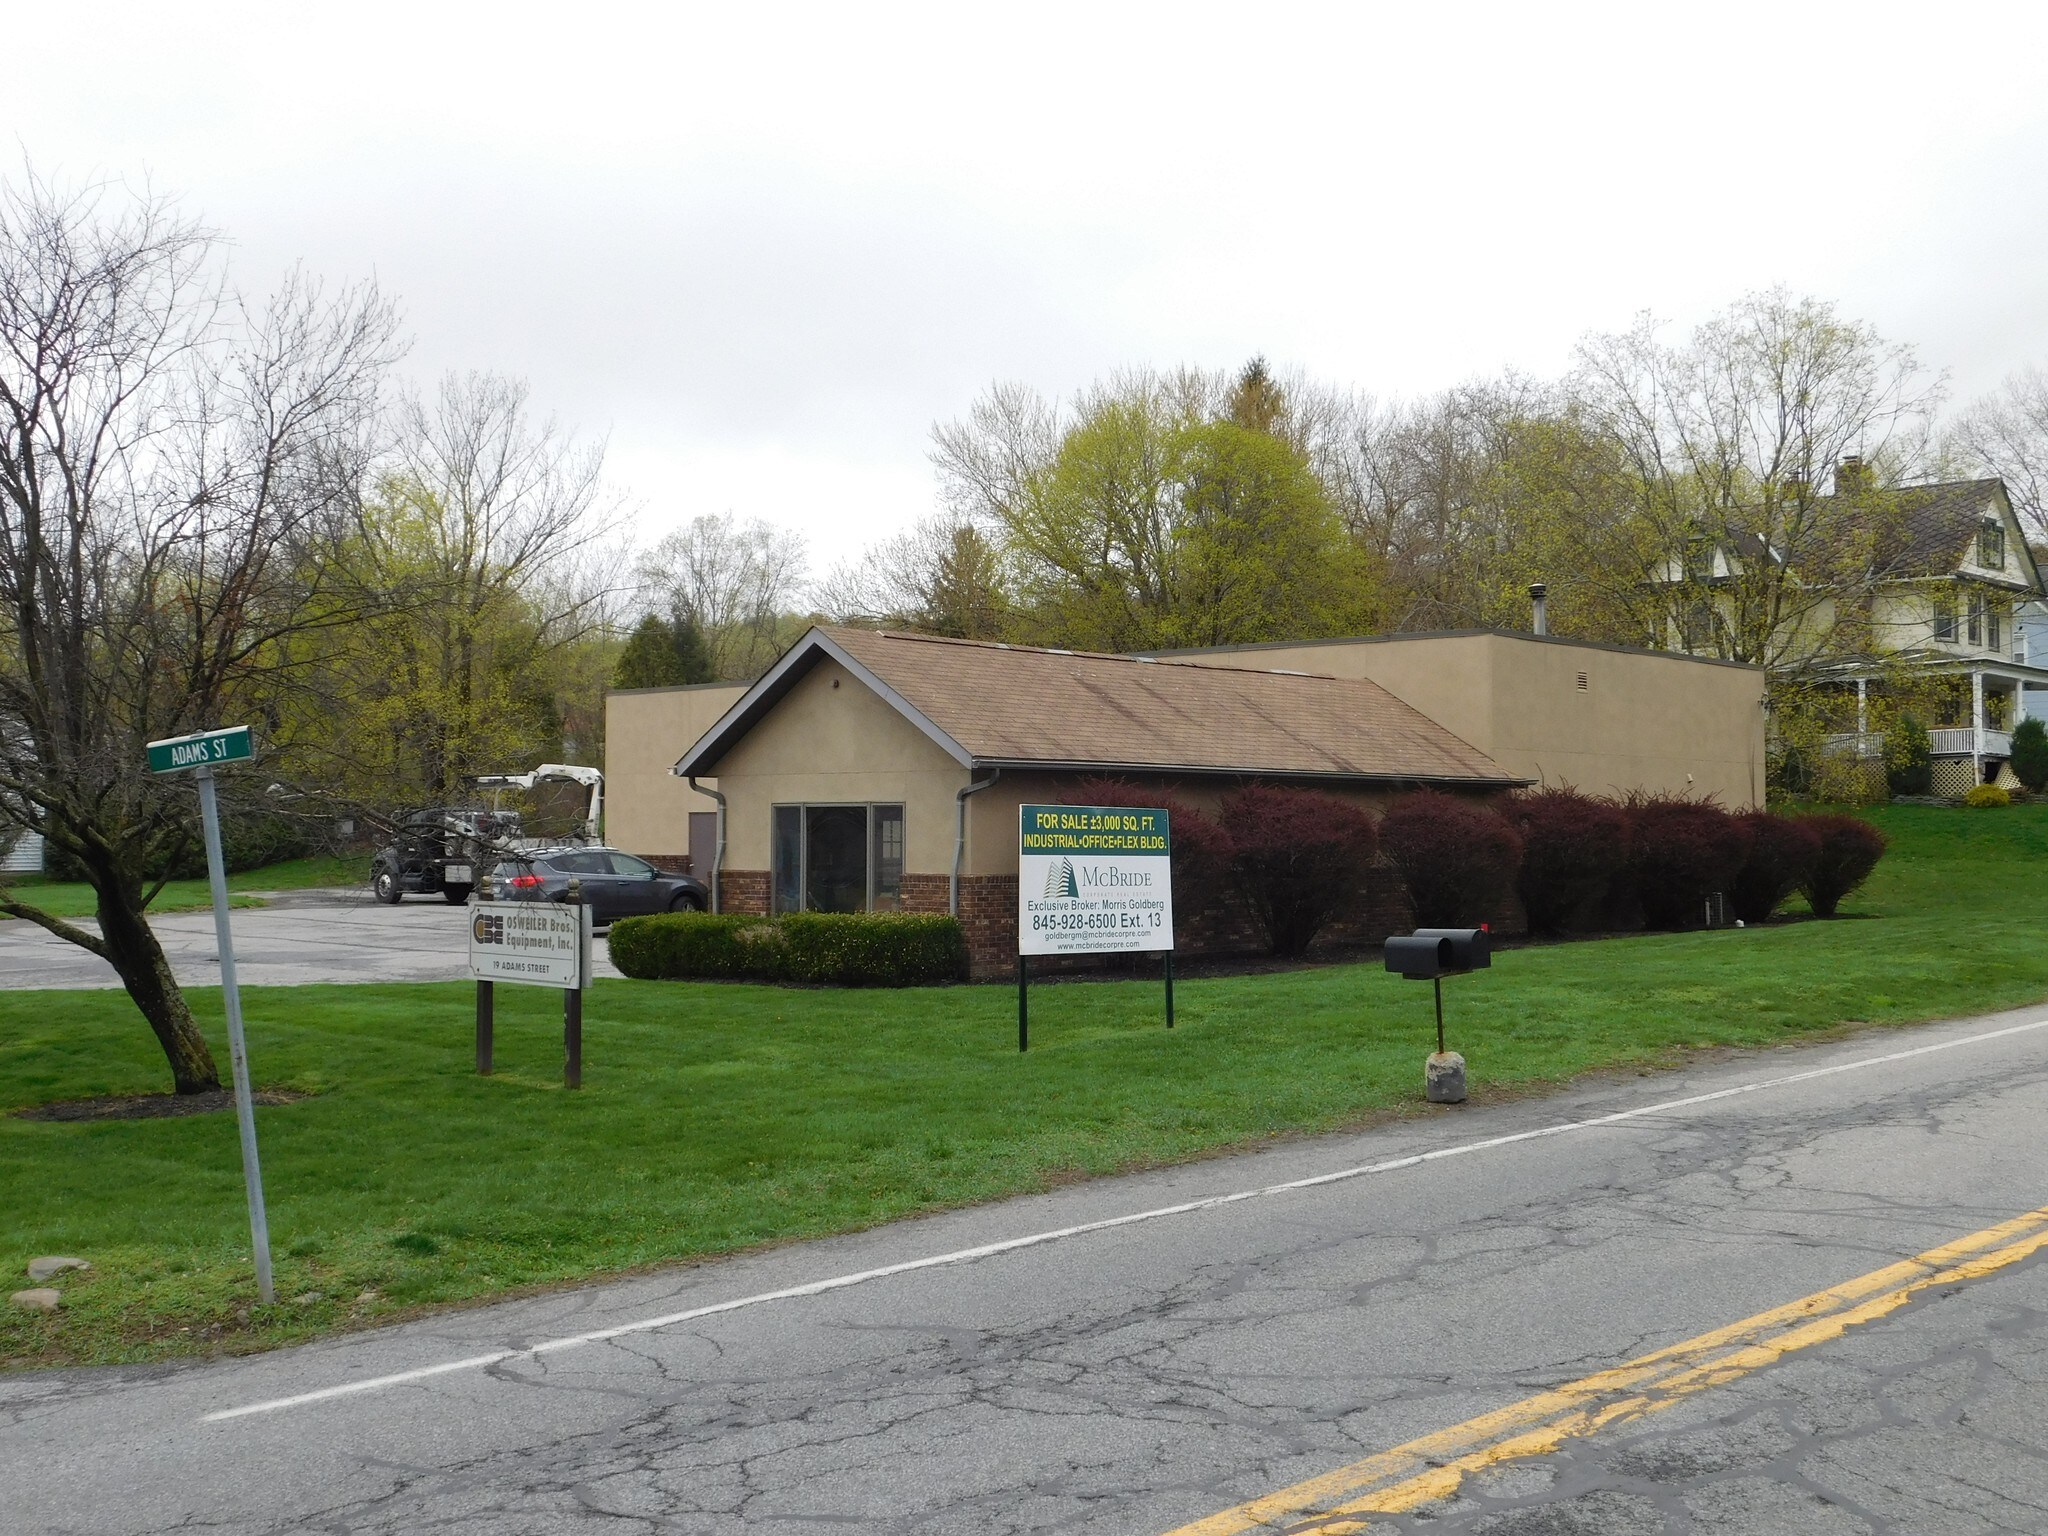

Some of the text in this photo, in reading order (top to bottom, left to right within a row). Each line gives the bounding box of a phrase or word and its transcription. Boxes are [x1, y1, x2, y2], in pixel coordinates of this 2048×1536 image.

[172, 738, 227, 766] ADAMS ST
[1036, 814, 1155, 832] FOR SALE ±3,000 SQ. FT.
[1140, 836, 1167, 849] BLDG.
[1028, 899, 1164, 911] Exclusive Broker: Morris Goldberg
[507, 917, 573, 933] OSWEILER Bros.
[1033, 913, 1161, 930] 845-928-6500 Ext. 13
[507, 933, 573, 951] Equipment, Inc.
[1045, 930, 1151, 941] goldbergm@mcbridecorpre.com
[1058, 941, 1140, 950] www.mcbridecorpre.com
[502, 962, 525, 972] ADAMS
[528, 964, 550, 973] STREET
